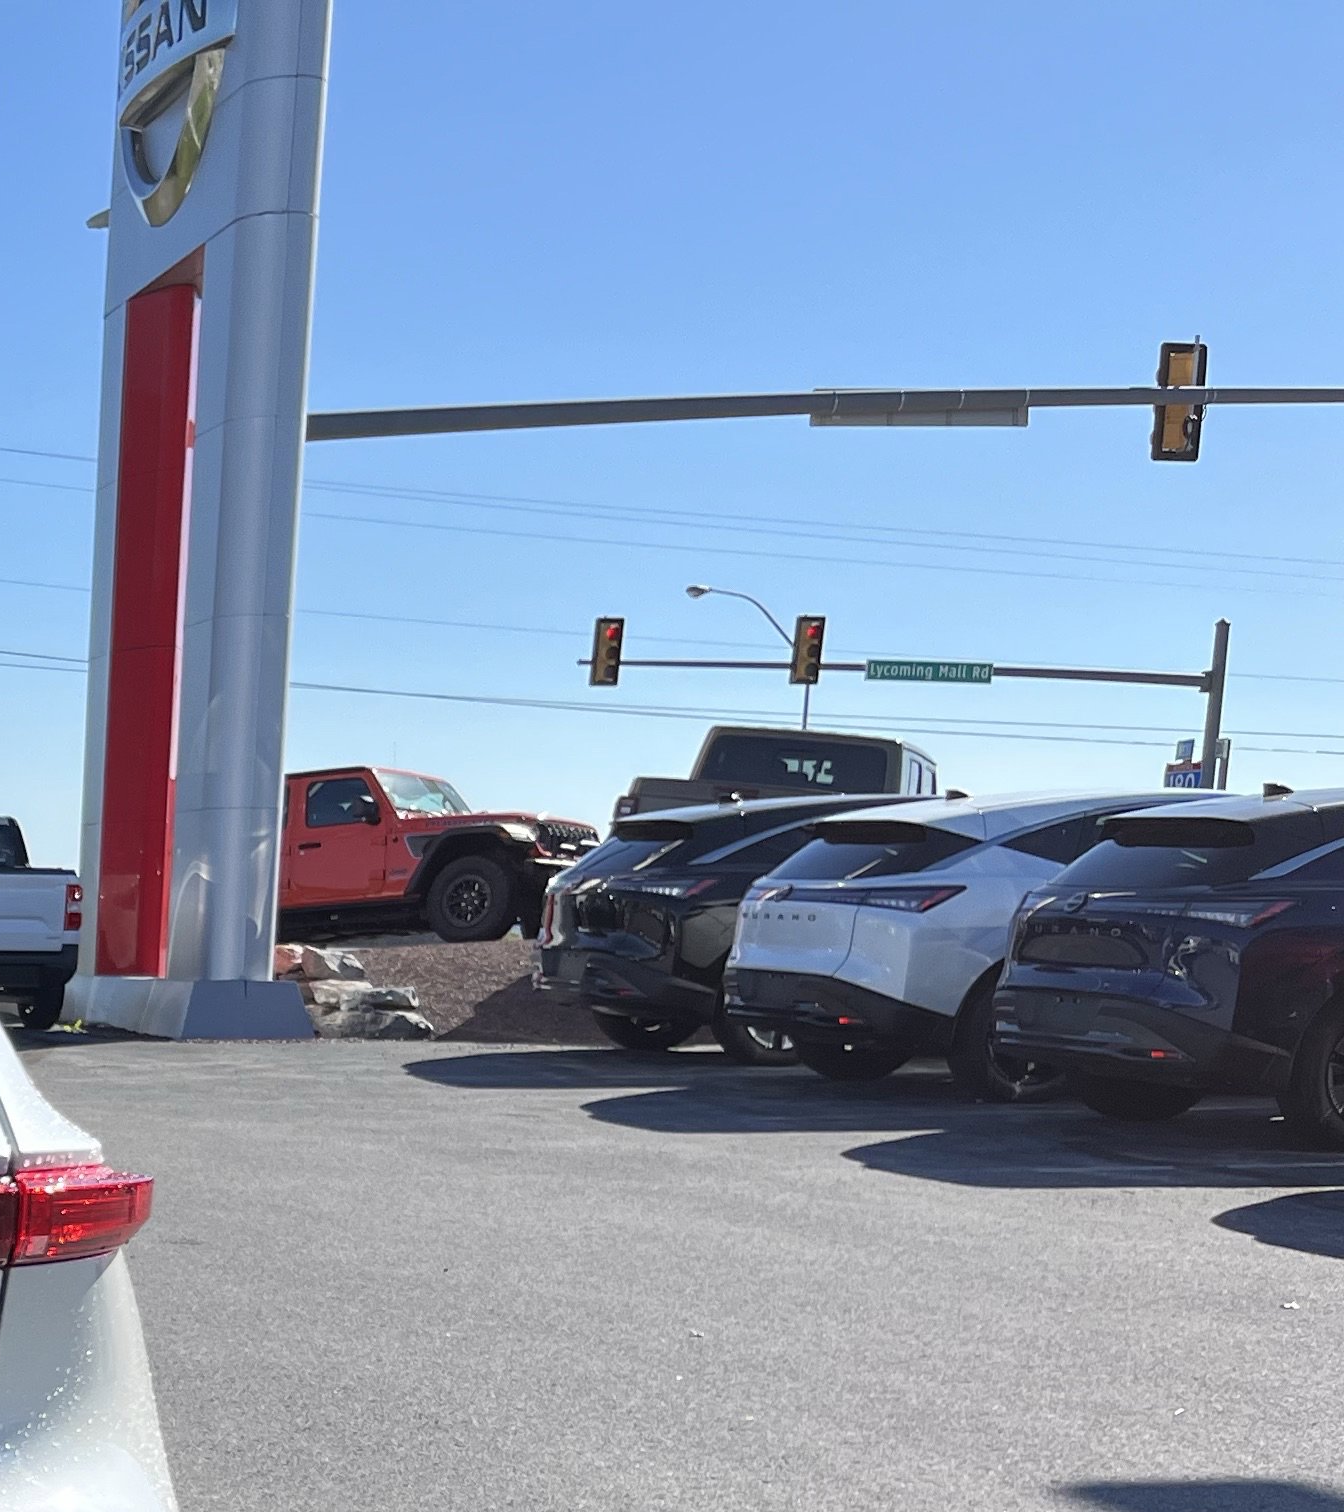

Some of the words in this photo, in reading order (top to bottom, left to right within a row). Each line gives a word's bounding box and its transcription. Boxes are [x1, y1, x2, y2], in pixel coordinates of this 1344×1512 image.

[120, 0, 207, 91] SSAN
[870, 663, 933, 680] Lycoming
[938, 665, 966, 679] Mall
[972, 666, 990, 679] Rd
[1169, 773, 1196, 788] 180
